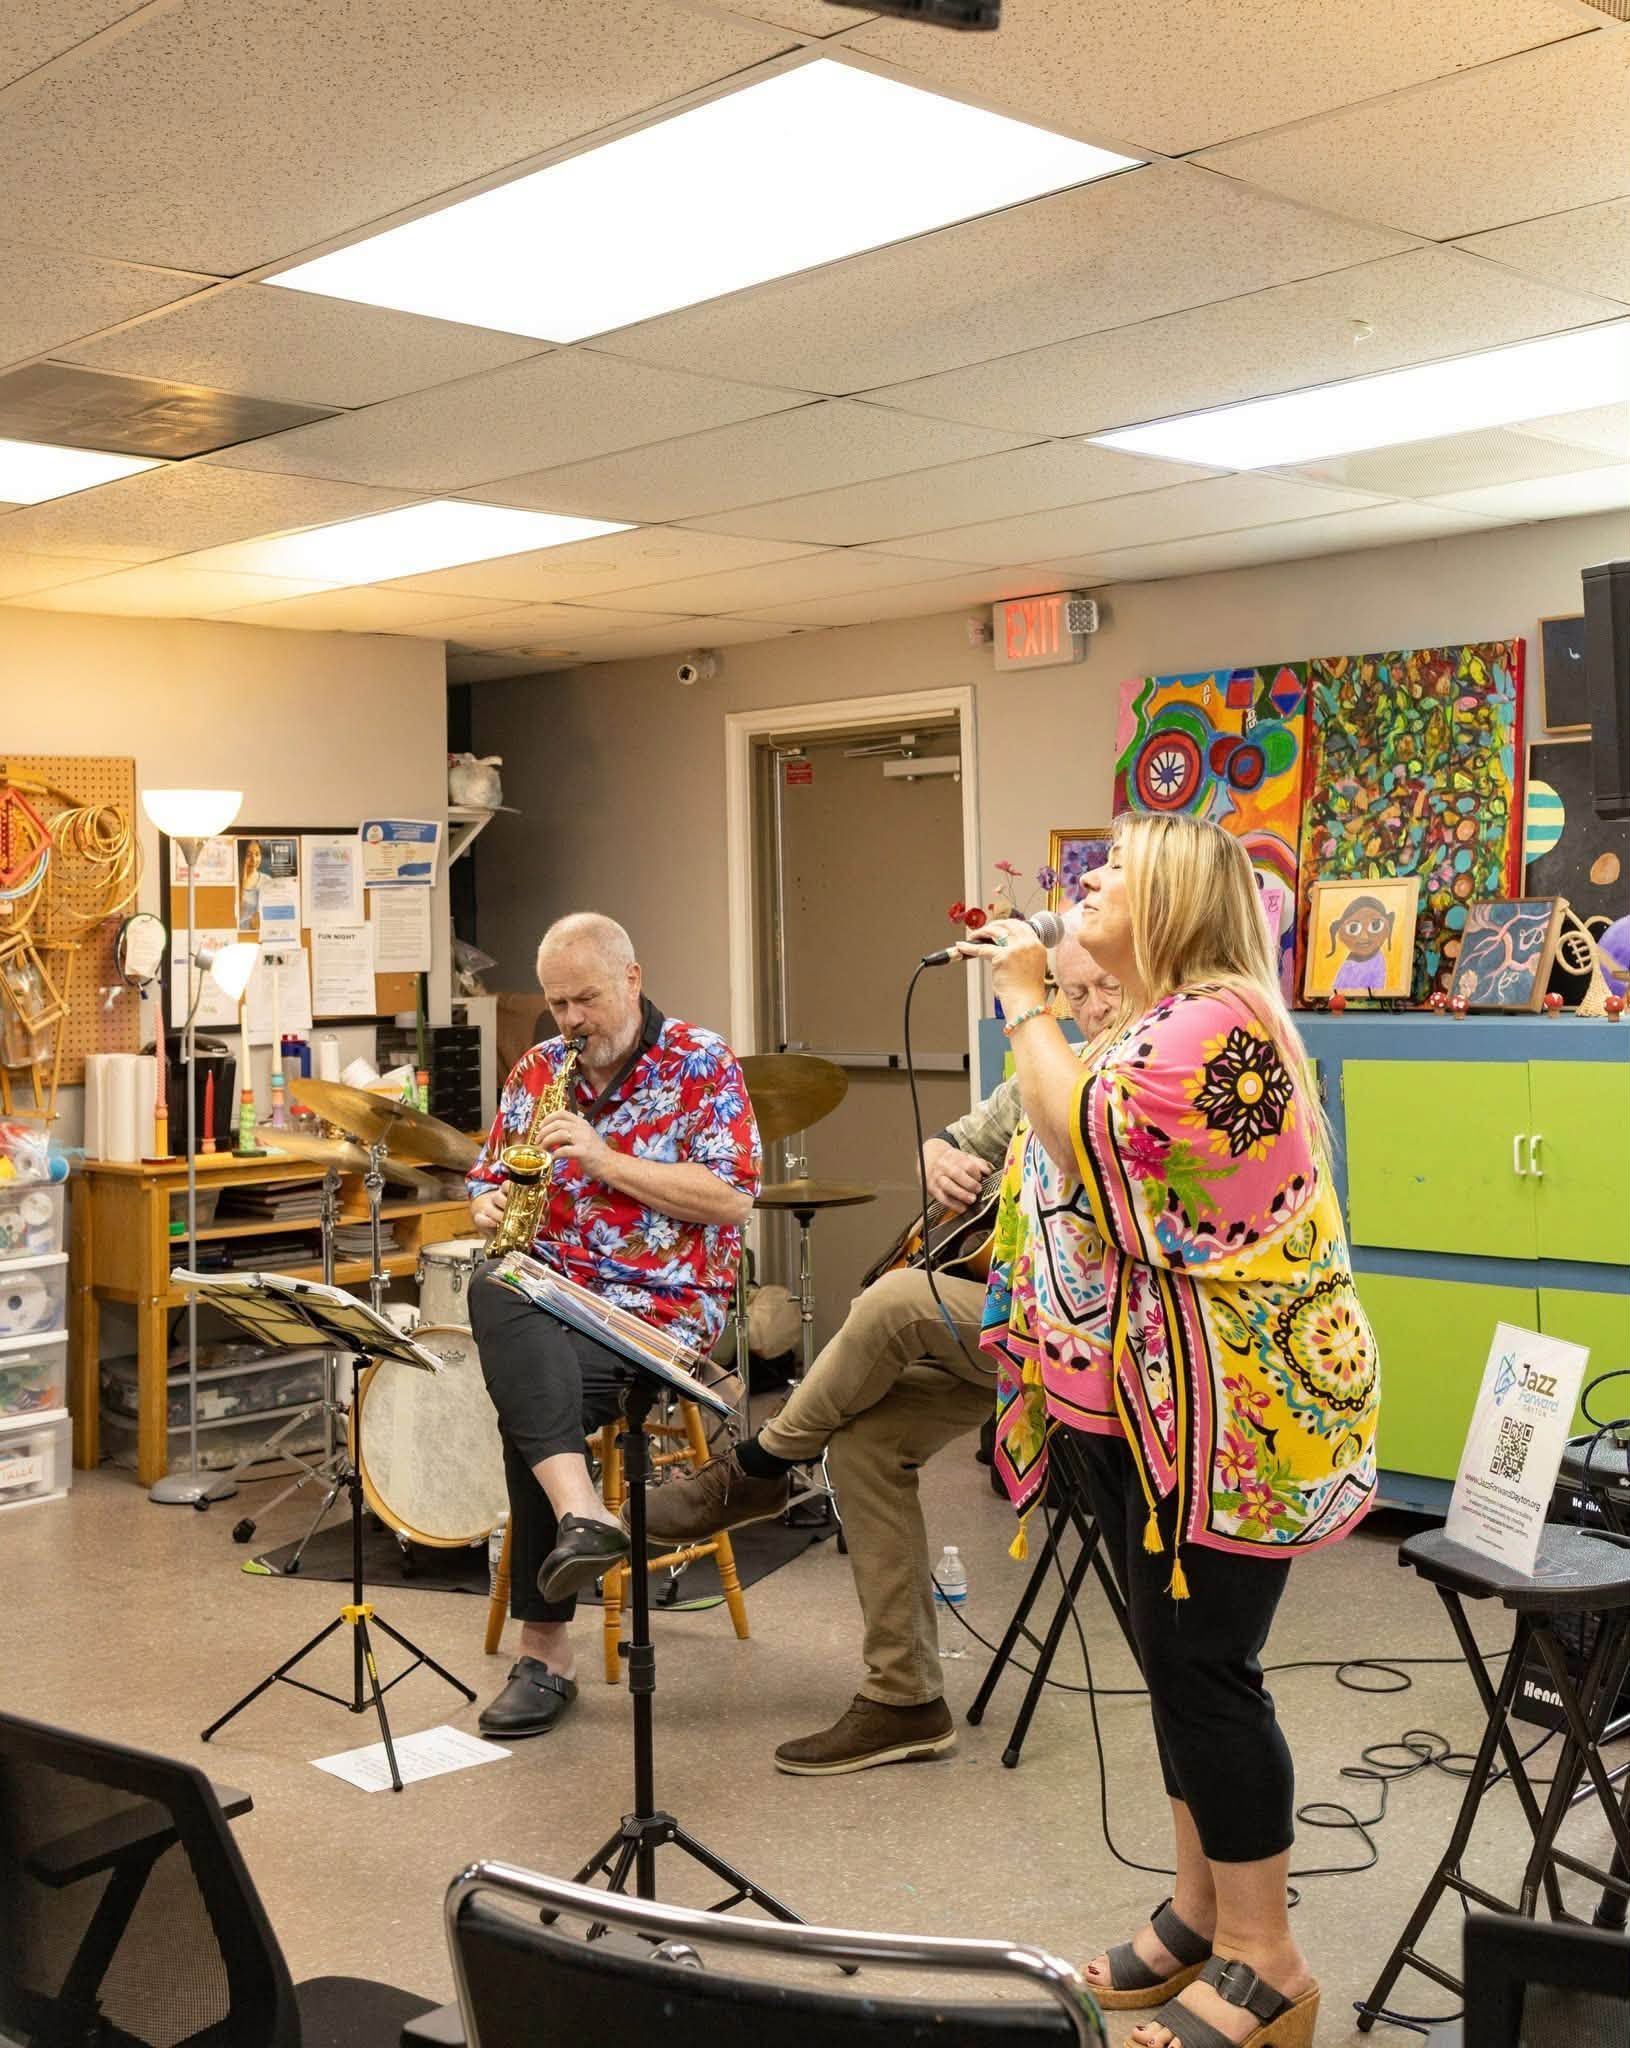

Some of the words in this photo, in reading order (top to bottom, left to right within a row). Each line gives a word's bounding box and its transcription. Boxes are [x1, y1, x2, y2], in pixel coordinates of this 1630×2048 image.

[1005, 598, 1061, 658] EXIT
[334, 933, 356, 941] NIGHT
[1518, 1363, 1557, 1398] Jazz
[1518, 1389, 1560, 1412] Forward
[1464, 1473, 1541, 1512] www.JazzForwardDayton.org
